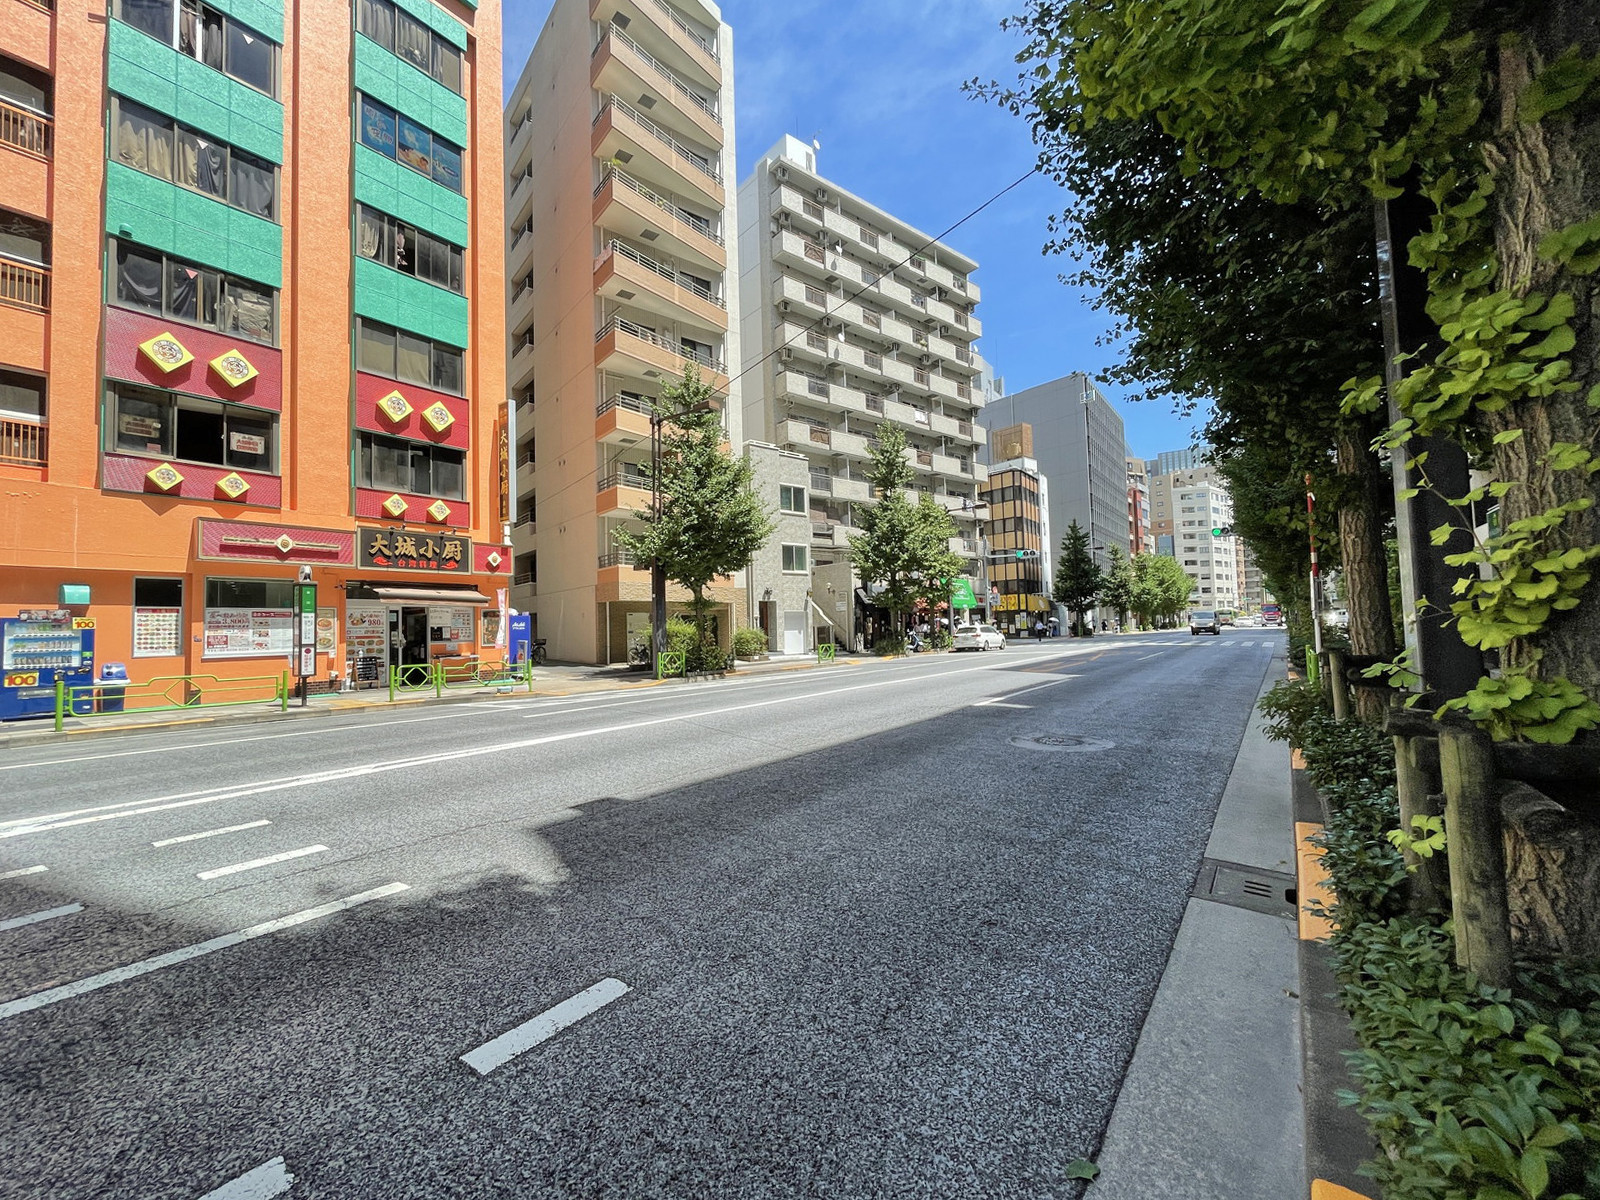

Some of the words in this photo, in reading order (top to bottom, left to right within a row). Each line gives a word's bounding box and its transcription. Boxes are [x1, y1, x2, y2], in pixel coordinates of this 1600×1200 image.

[368, 533, 462, 561] 大城小厨
[75, 621, 95, 629] 100
[7, 675, 37, 687] 100
